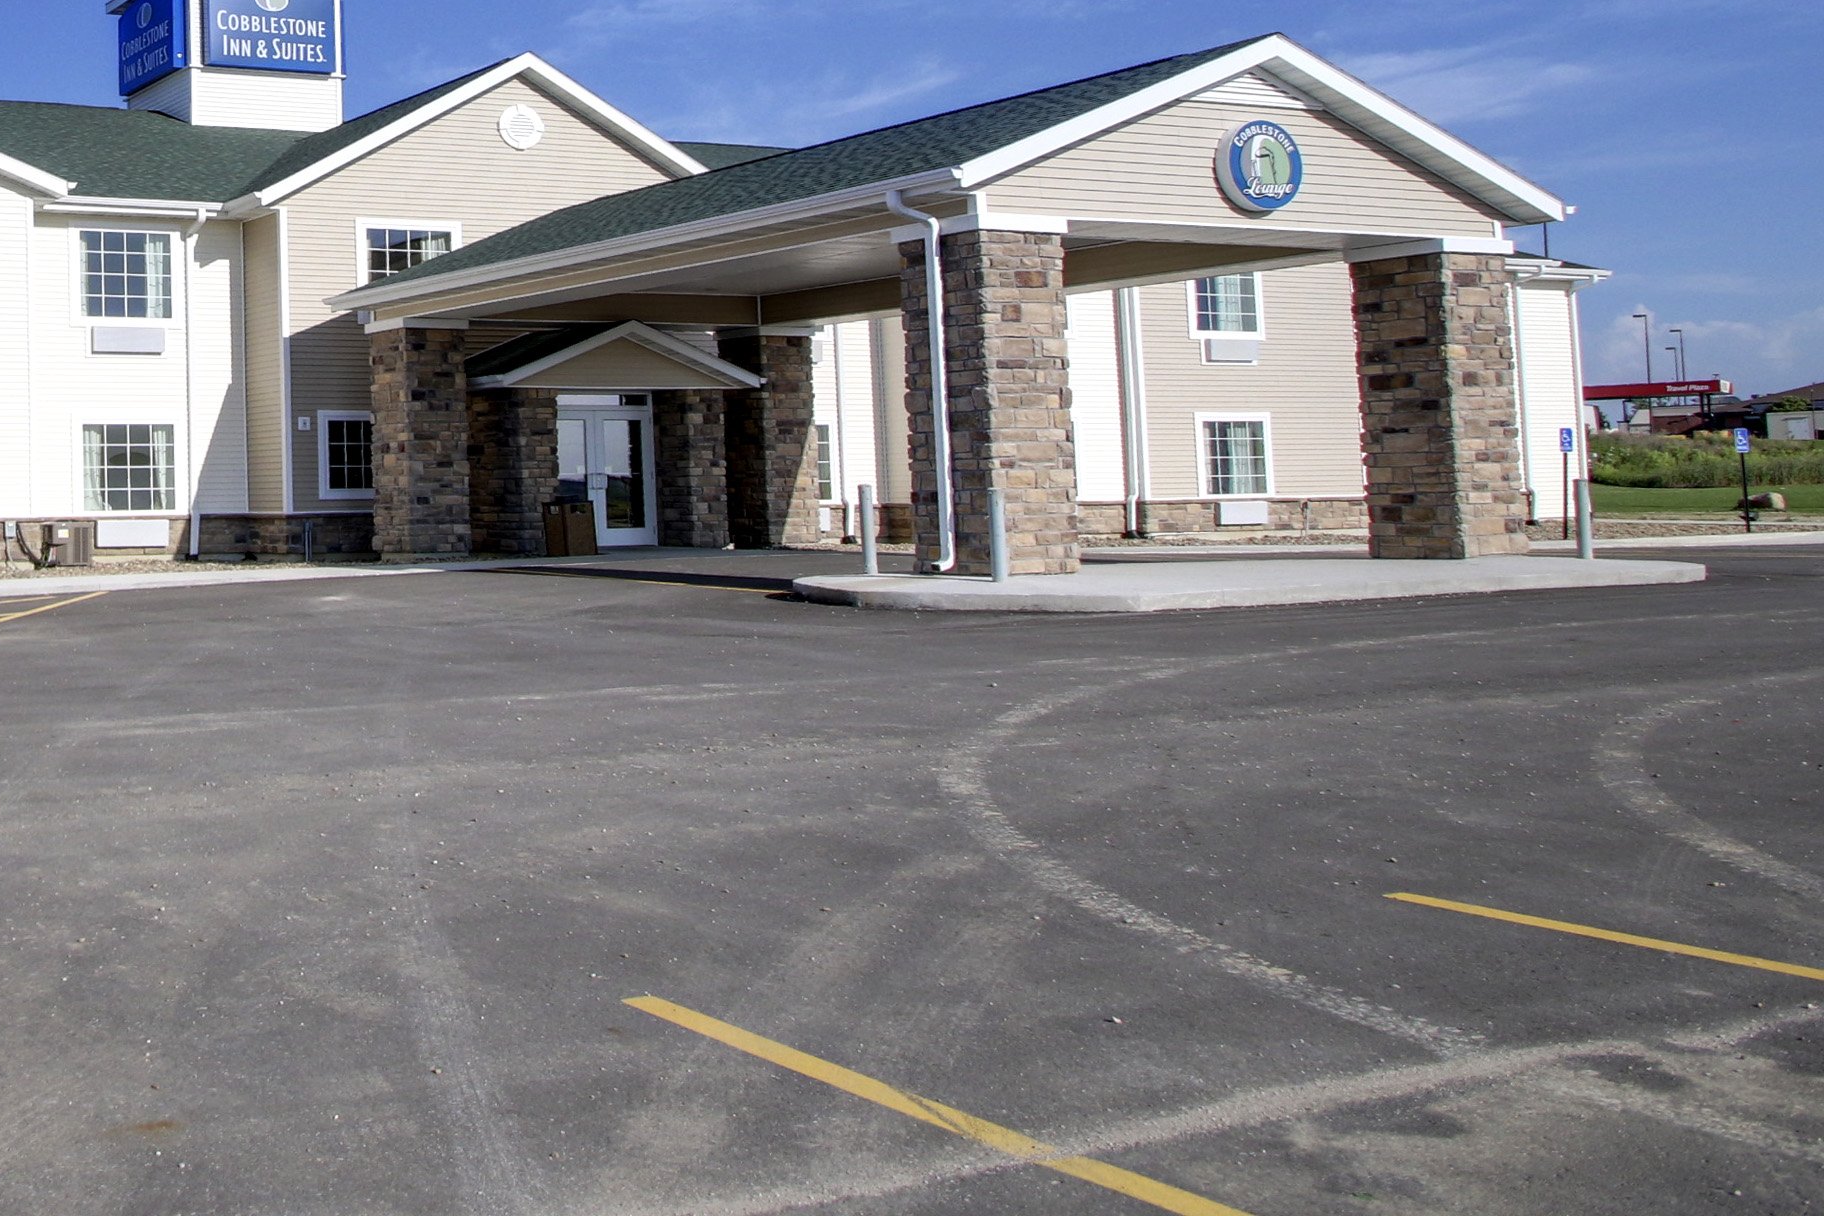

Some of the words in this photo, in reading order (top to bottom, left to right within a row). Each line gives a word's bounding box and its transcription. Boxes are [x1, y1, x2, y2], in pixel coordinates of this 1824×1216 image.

[217, 10, 326, 38] COBBLESTONE
[223, 35, 251, 58] INN
[256, 39, 268, 59] &
[137, 58, 143, 77] &
[1234, 125, 1294, 153] COBBLESTONE
[1243, 177, 1293, 199] Lounge
